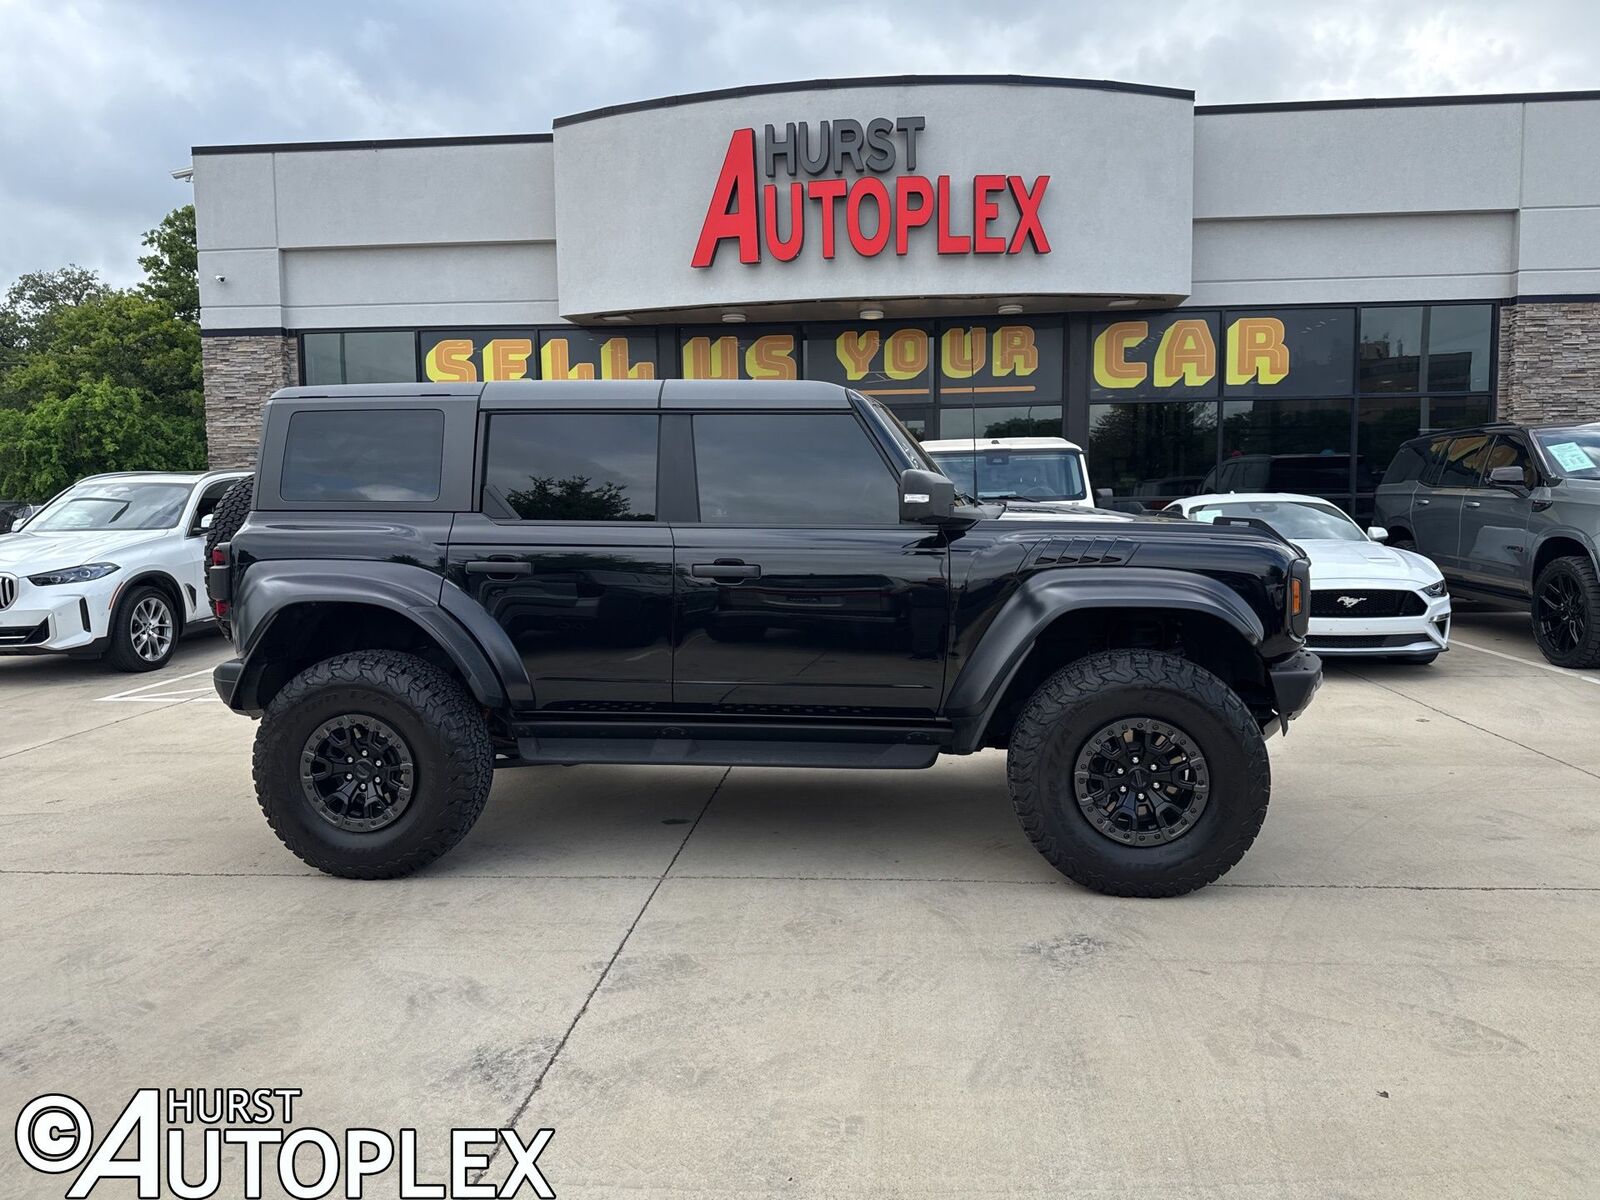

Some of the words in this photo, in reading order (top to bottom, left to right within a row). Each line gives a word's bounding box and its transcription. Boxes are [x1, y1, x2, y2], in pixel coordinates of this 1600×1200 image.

[765, 116, 925, 177] HURST
[691, 128, 1051, 268] AUTOPLEX
[425, 338, 655, 383] SELL
[683, 335, 797, 380] US
[836, 325, 1038, 380] YOUR
[1093, 317, 1289, 389] CAR
